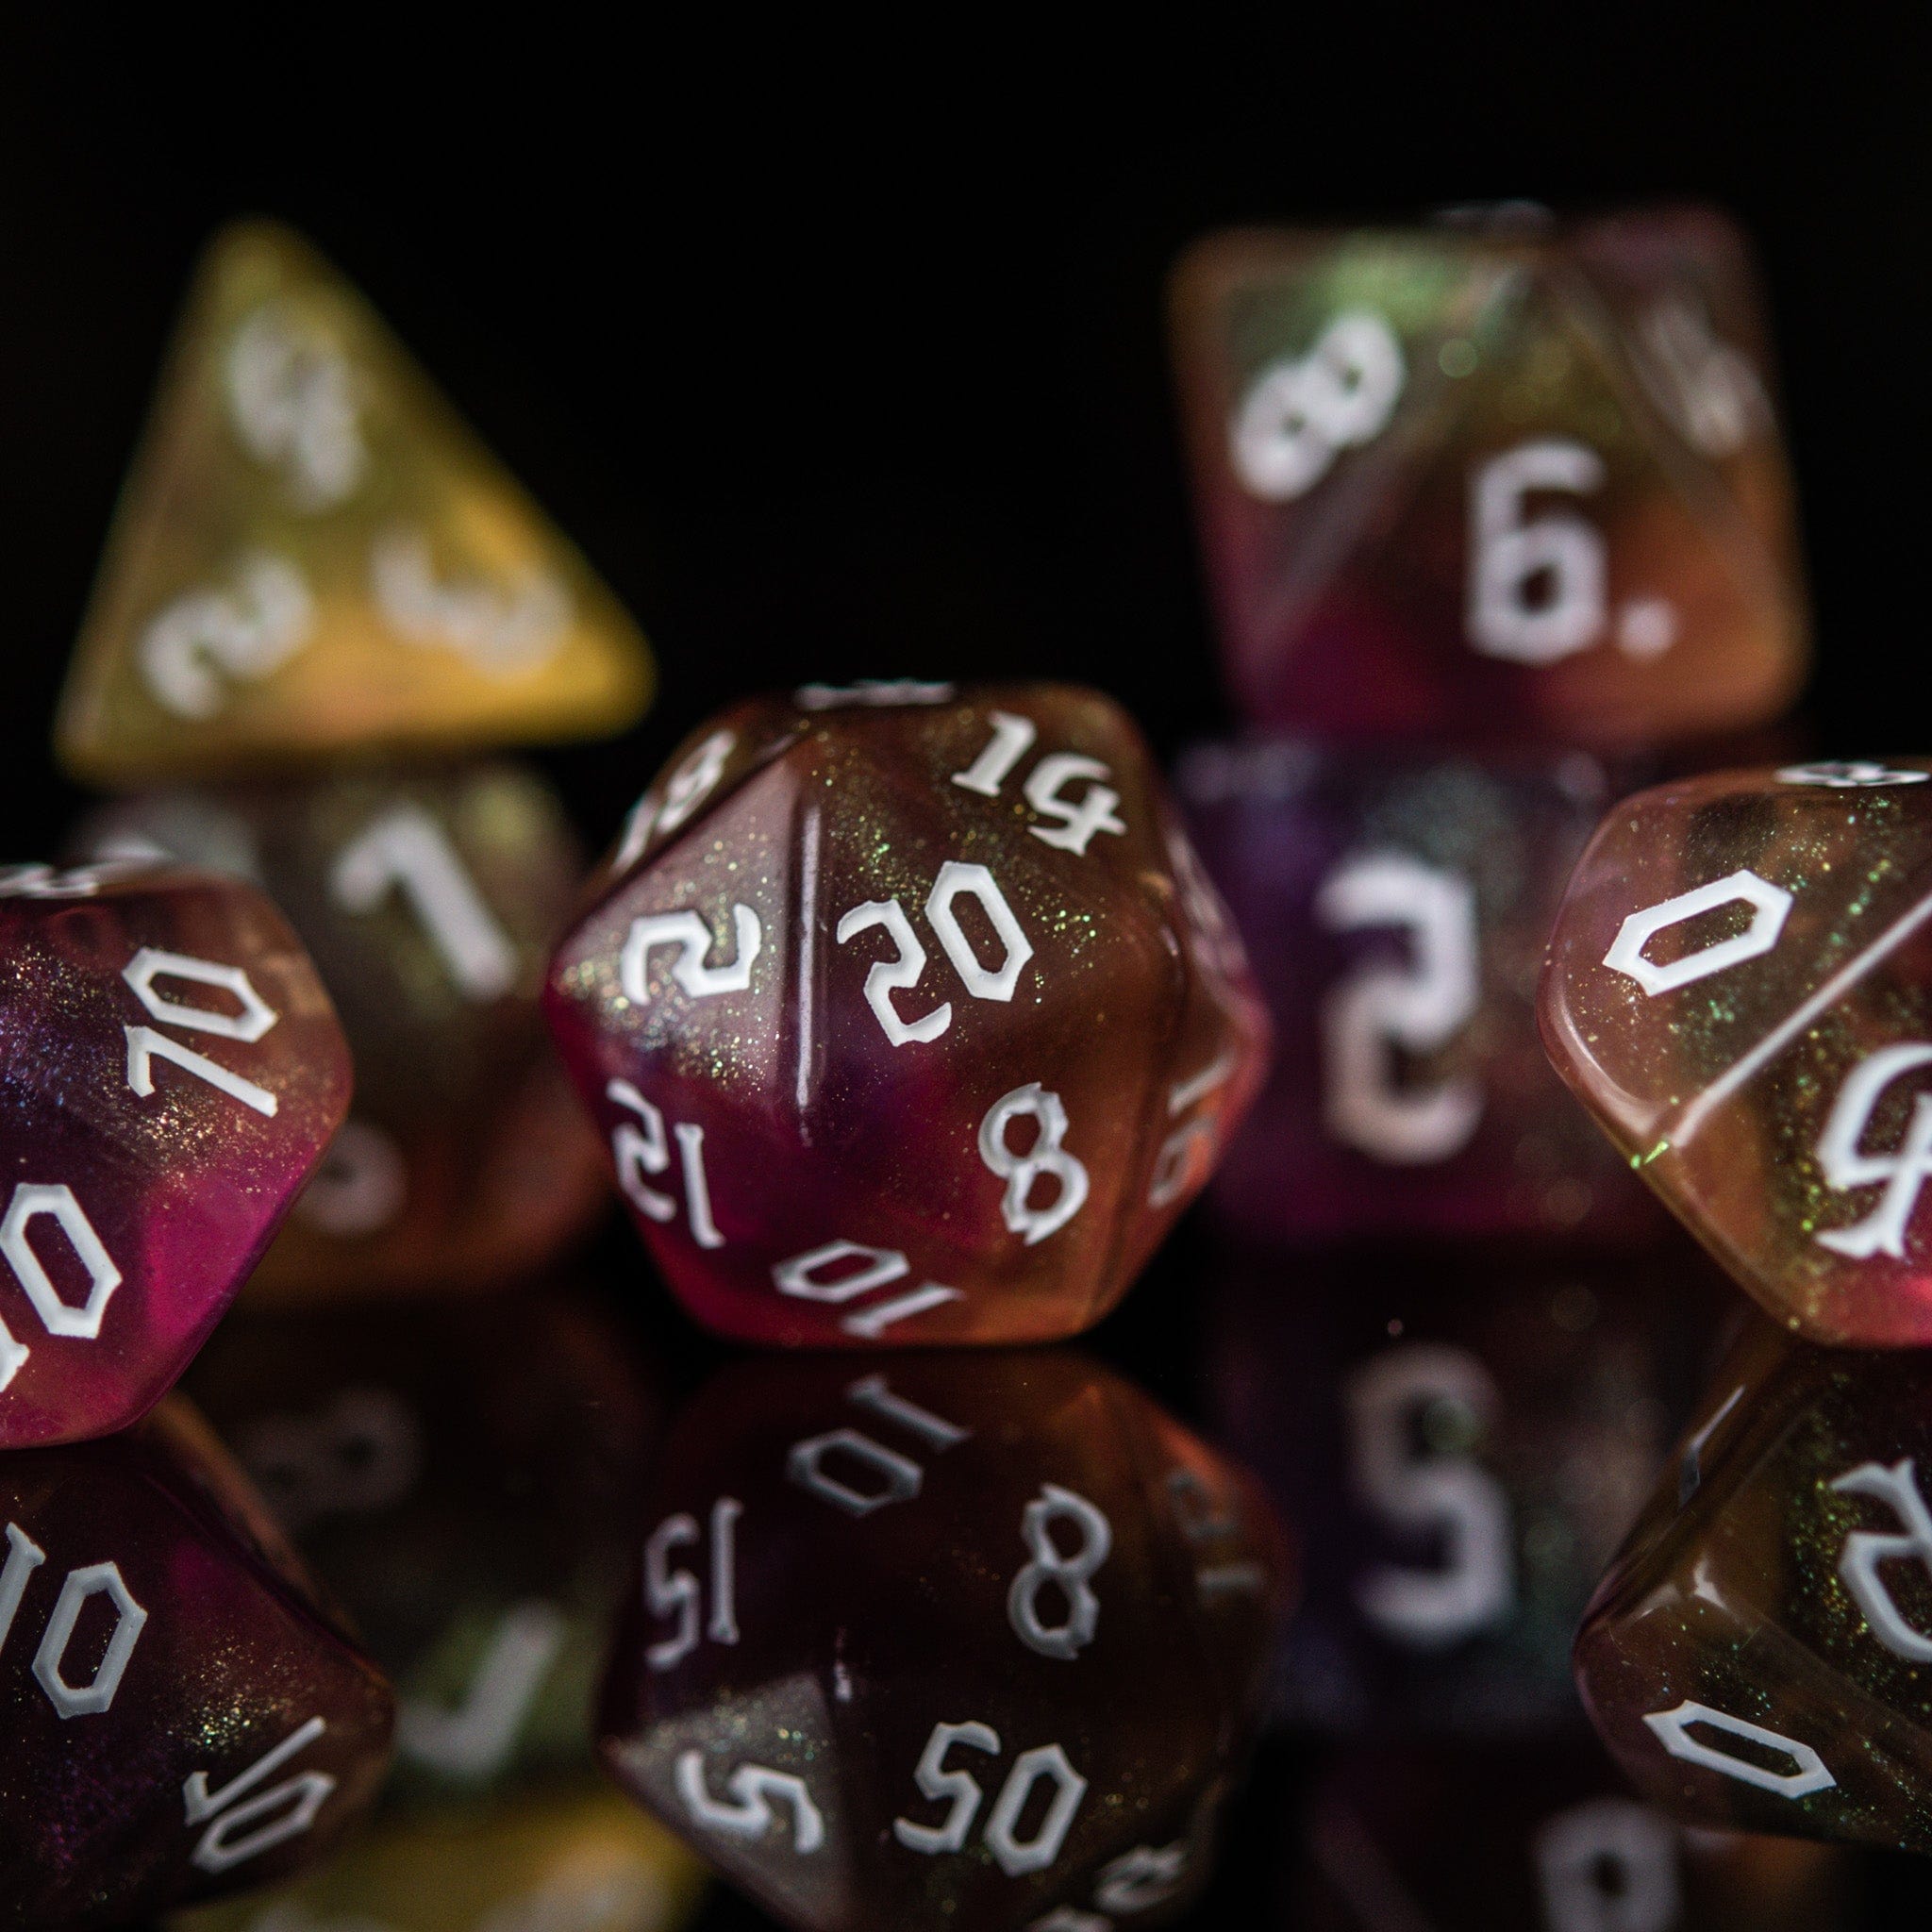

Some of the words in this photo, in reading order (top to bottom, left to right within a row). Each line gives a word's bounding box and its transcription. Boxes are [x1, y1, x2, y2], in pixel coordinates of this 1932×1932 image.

[1234, 311, 1406, 504] 8
[950, 708, 1128, 857] 14
[123, 946, 279, 1118] 70
[620, 902, 761, 1006] 2
[837, 859, 1035, 1047] 20
[977, 1081, 1089, 1243] 8
[770, 1238, 964, 1340] 10
